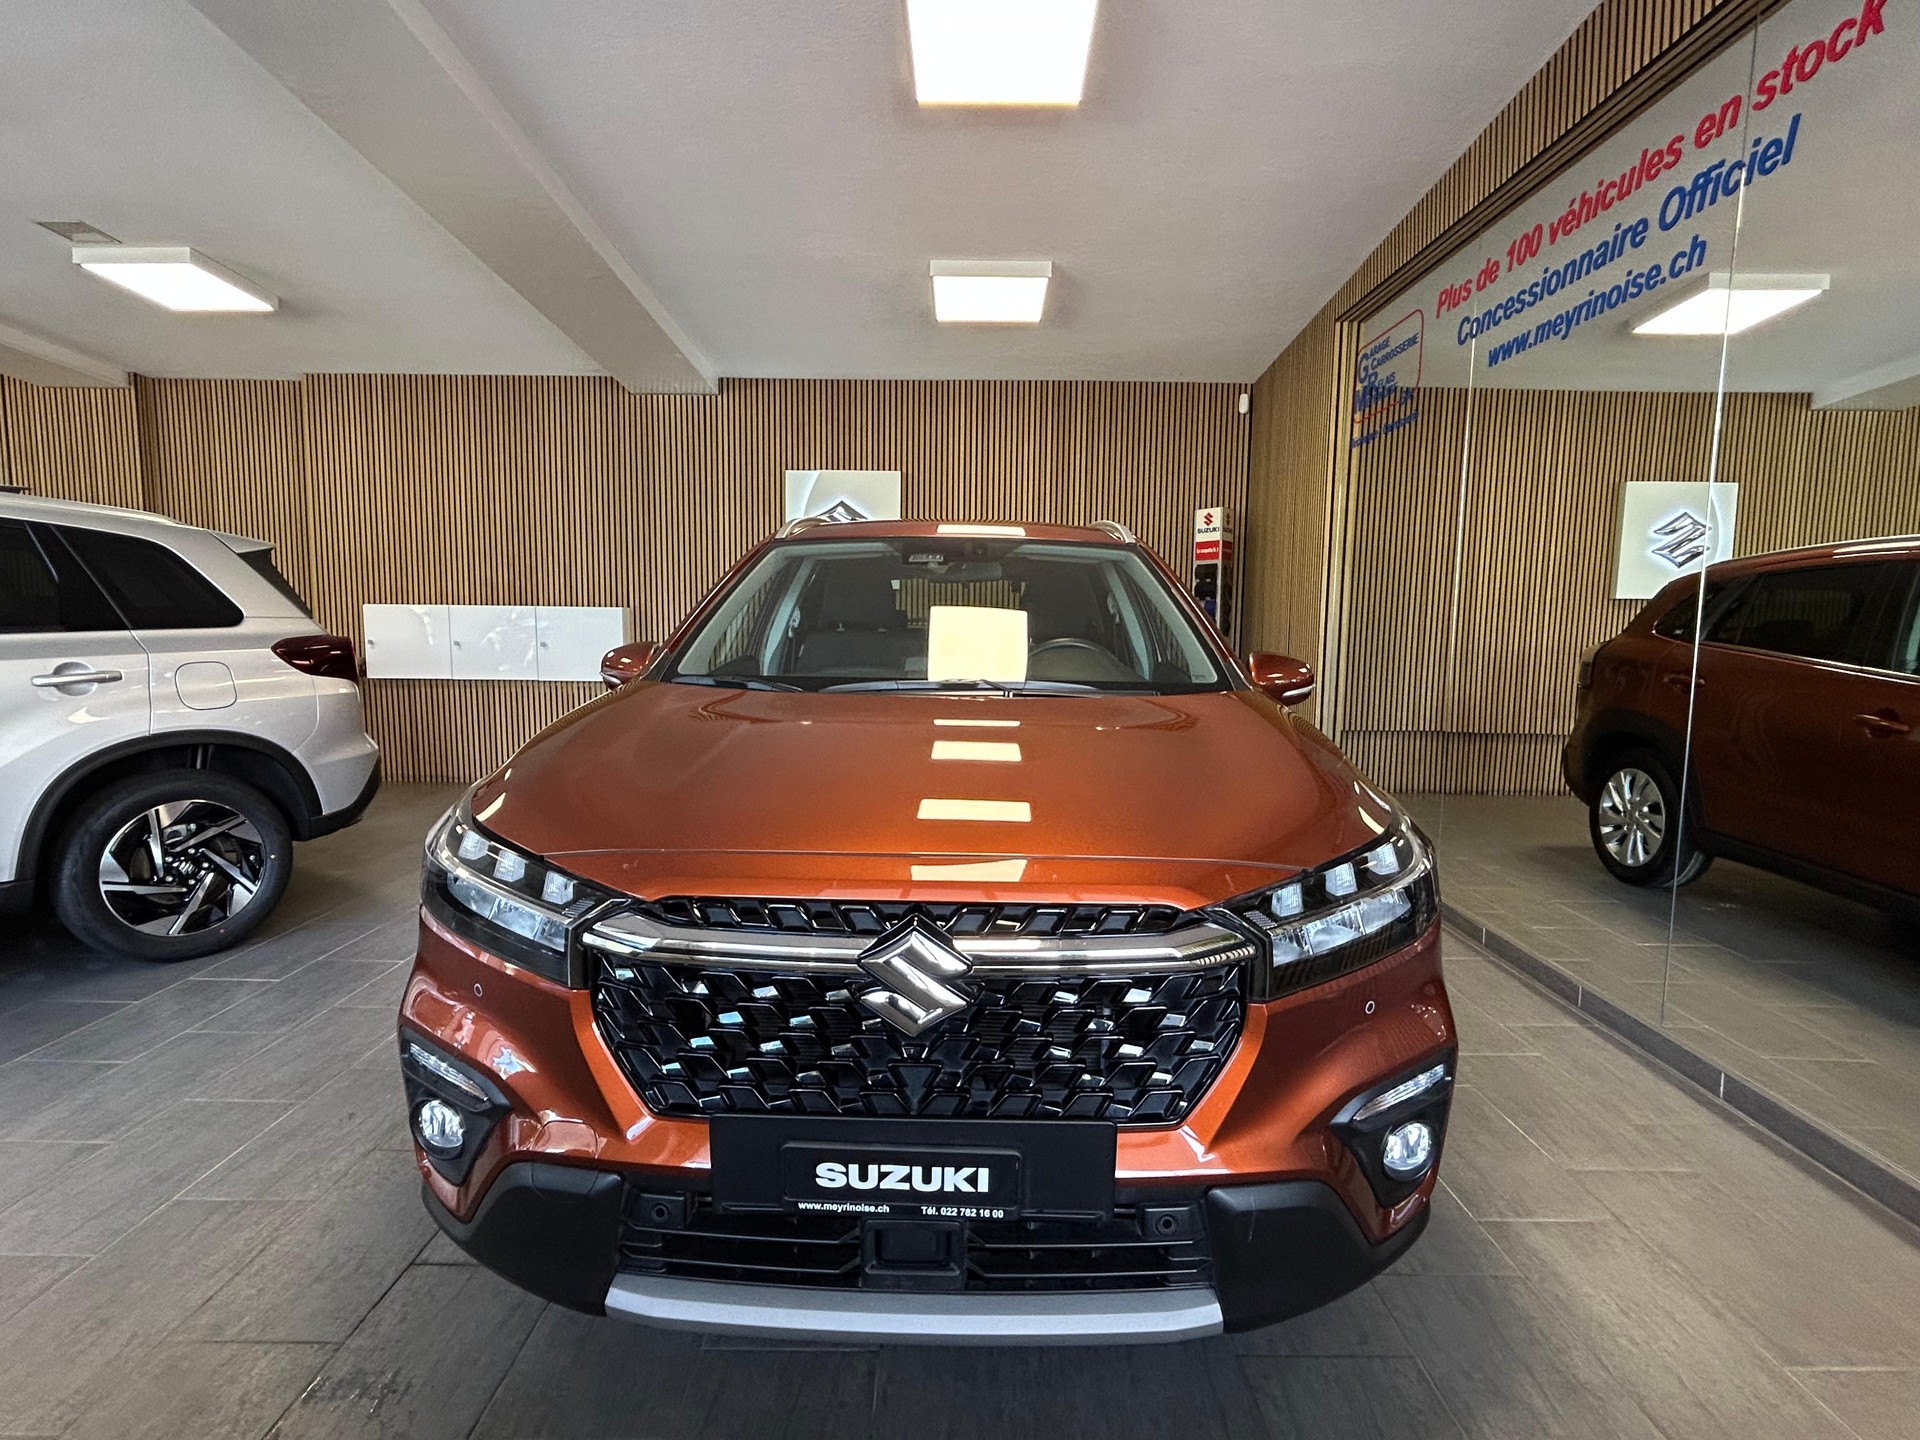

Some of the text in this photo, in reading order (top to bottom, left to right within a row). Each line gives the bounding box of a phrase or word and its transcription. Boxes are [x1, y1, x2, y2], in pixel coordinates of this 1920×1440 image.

[1436, 0, 1888, 318] Plus de 100 véhicules en stock
[1457, 113, 1802, 346] Concessionnaire Officiel
[1488, 234, 1707, 367] www.meyrinoise.ch
[1197, 526, 1220, 534] SUZUKI
[815, 1162, 990, 1193] SUZUKI
[798, 1202, 890, 1214] www.meyrinoise.ch
[920, 1206, 1004, 1218] Tél. 022 782 16 00
